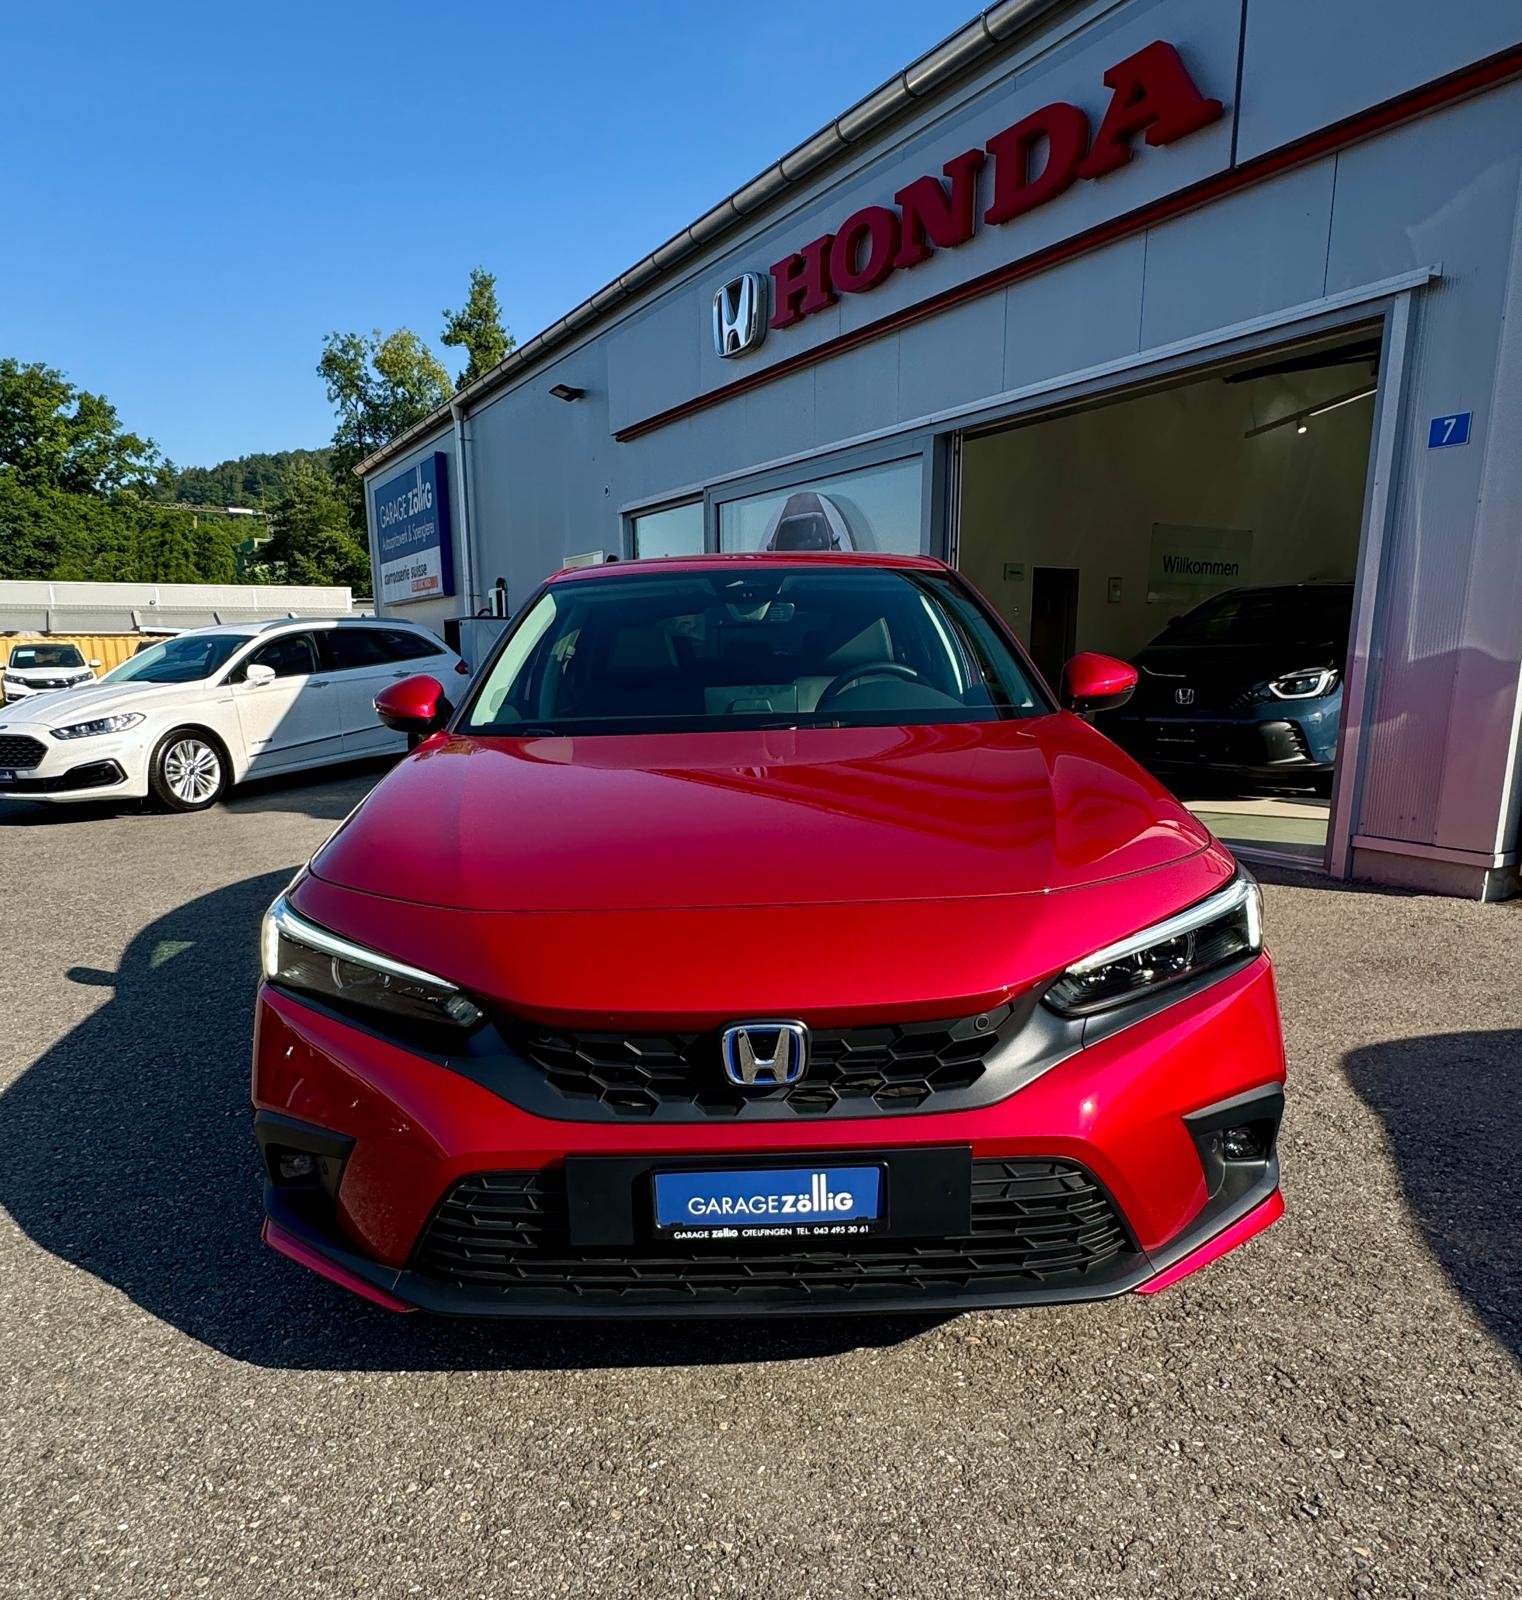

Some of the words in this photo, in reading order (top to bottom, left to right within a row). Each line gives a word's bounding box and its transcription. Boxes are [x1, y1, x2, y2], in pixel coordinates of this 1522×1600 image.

[769, 39, 1224, 330] HONDA
[1442, 418, 1457, 443] 7
[379, 494, 407, 528] GARAGE
[1162, 554, 1239, 576] Willkommen
[673, 1230, 710, 1239] GARAGE
[813, 1226, 829, 1235] 043
[830, 1226, 846, 1235] 495
[847, 1225, 858, 1234] 30
[859, 1225, 869, 1233] 61
